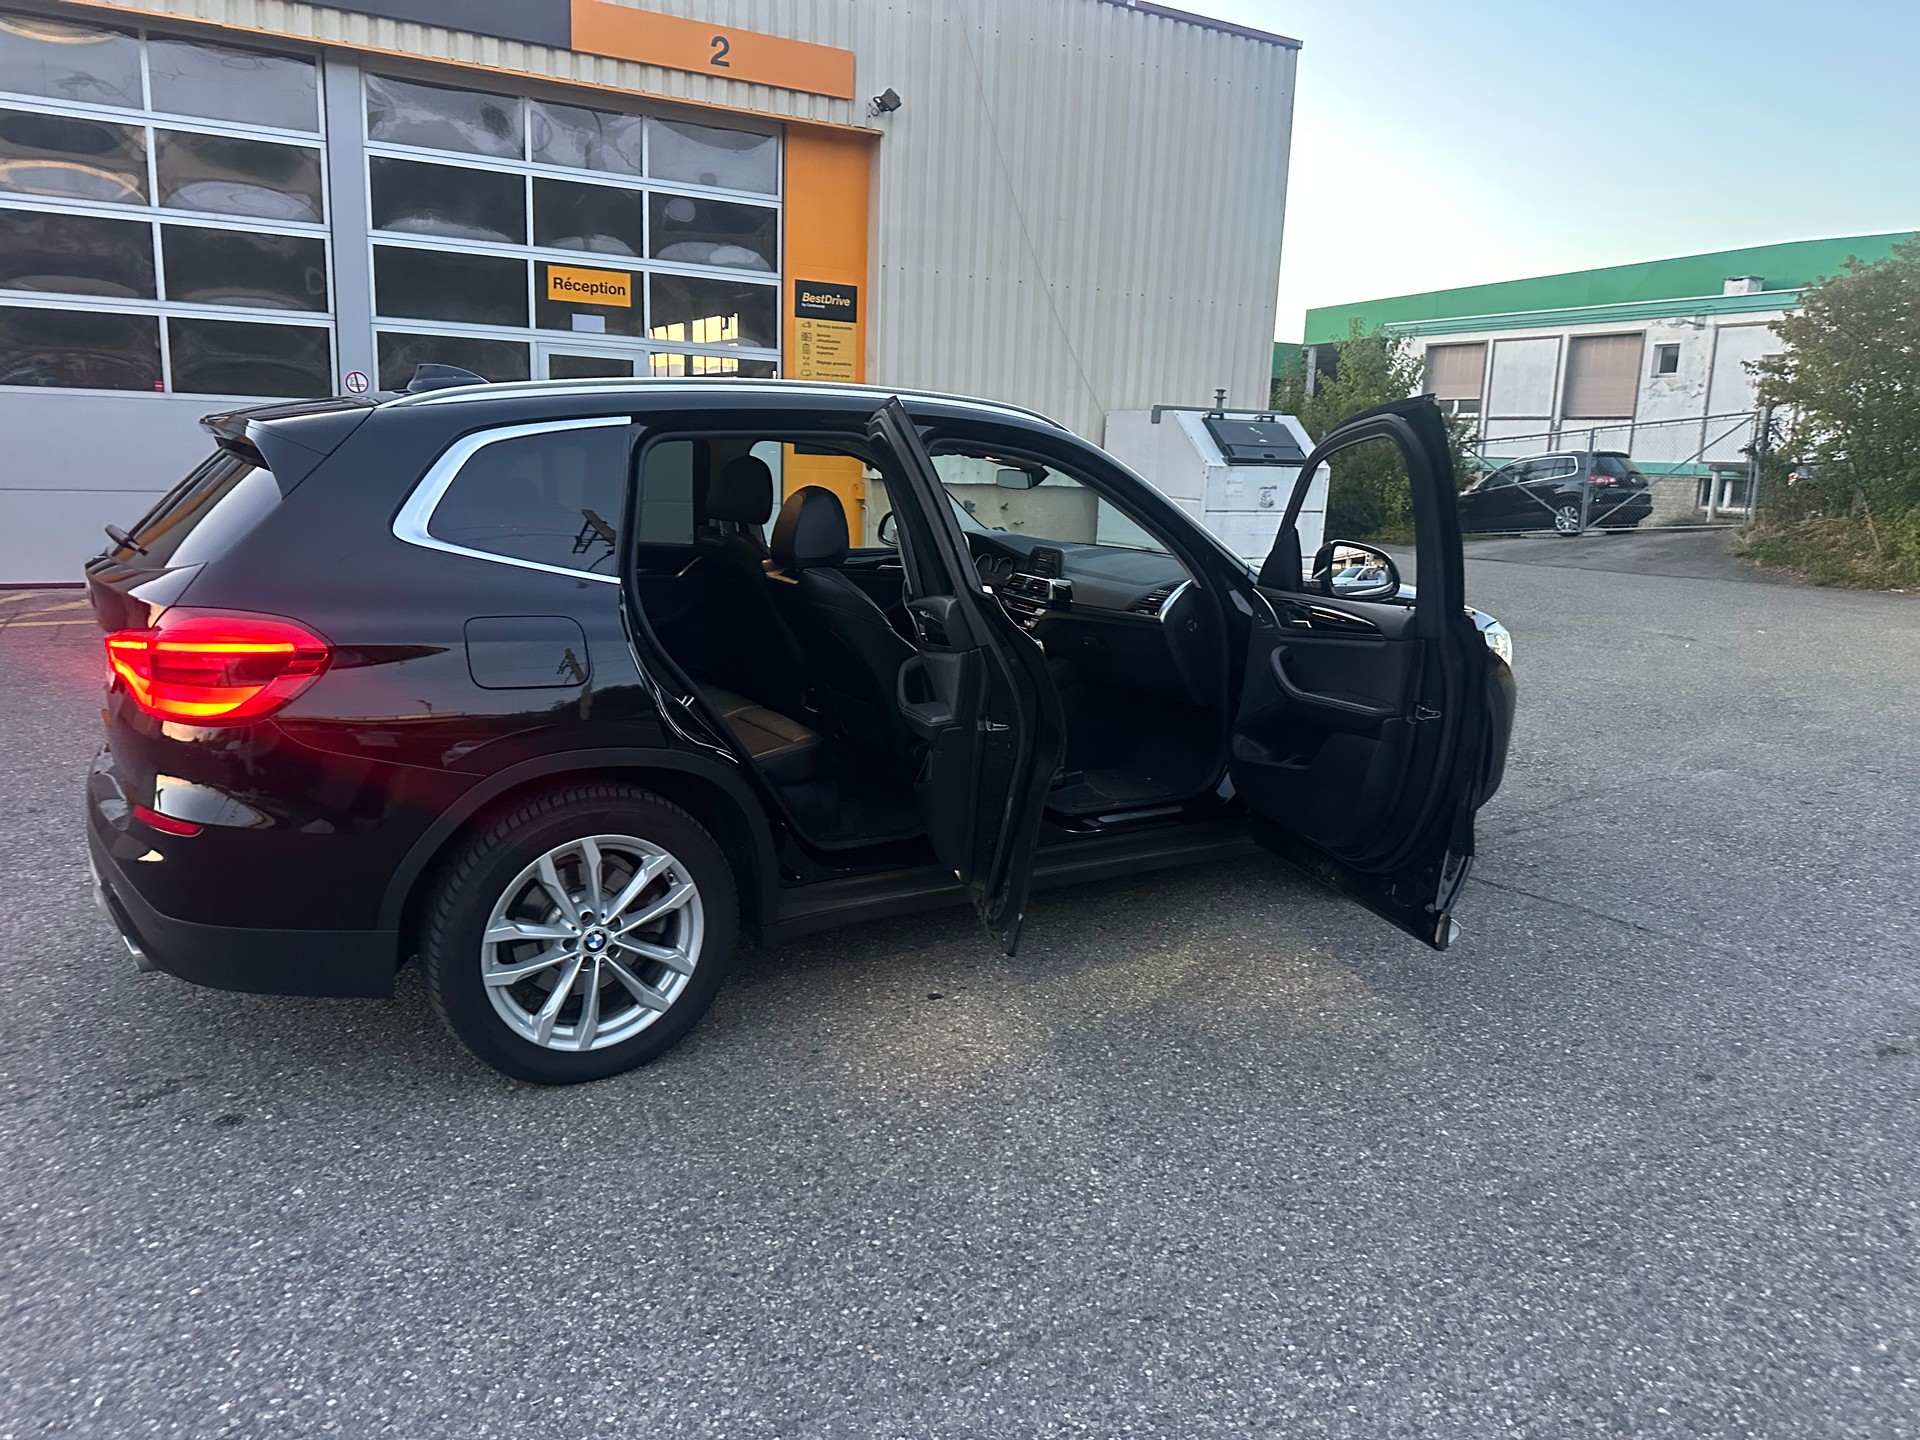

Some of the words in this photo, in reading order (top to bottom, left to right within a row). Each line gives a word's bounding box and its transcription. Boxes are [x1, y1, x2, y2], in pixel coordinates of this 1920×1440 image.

[710, 35, 730, 68] 2
[553, 276, 626, 296] Réception
[801, 291, 851, 307] BestDrive
